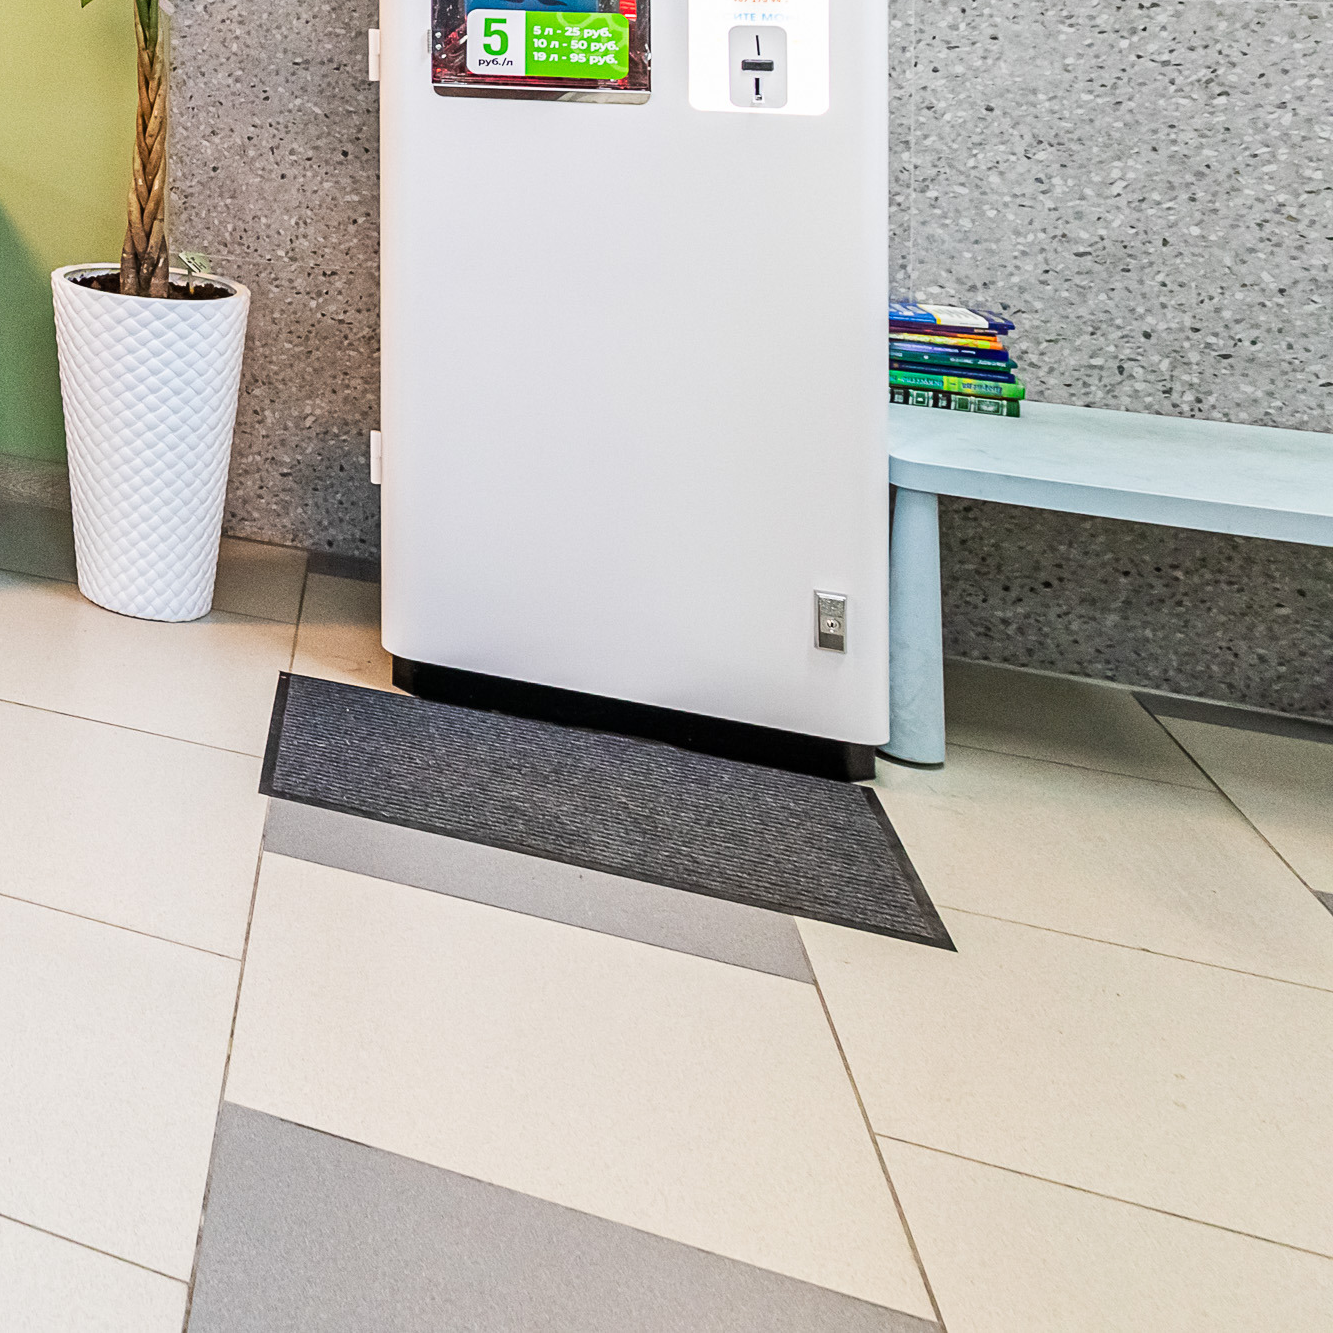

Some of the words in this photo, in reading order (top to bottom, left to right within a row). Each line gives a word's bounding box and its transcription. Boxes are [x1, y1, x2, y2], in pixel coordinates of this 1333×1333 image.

[483, 18, 509, 56] 5
[533, 26, 541, 35] 5
[544, 27, 553, 35] л
[564, 27, 580, 36] 25
[583, 27, 612, 39] руб.
[533, 38, 547, 48] 10
[570, 41, 588, 50] 50
[590, 40, 619, 52] руб.
[478, 58, 513, 66] руб./л
[533, 52, 546, 61] 19
[569, 53, 586, 63] 95
[589, 53, 618, 66] руб.
